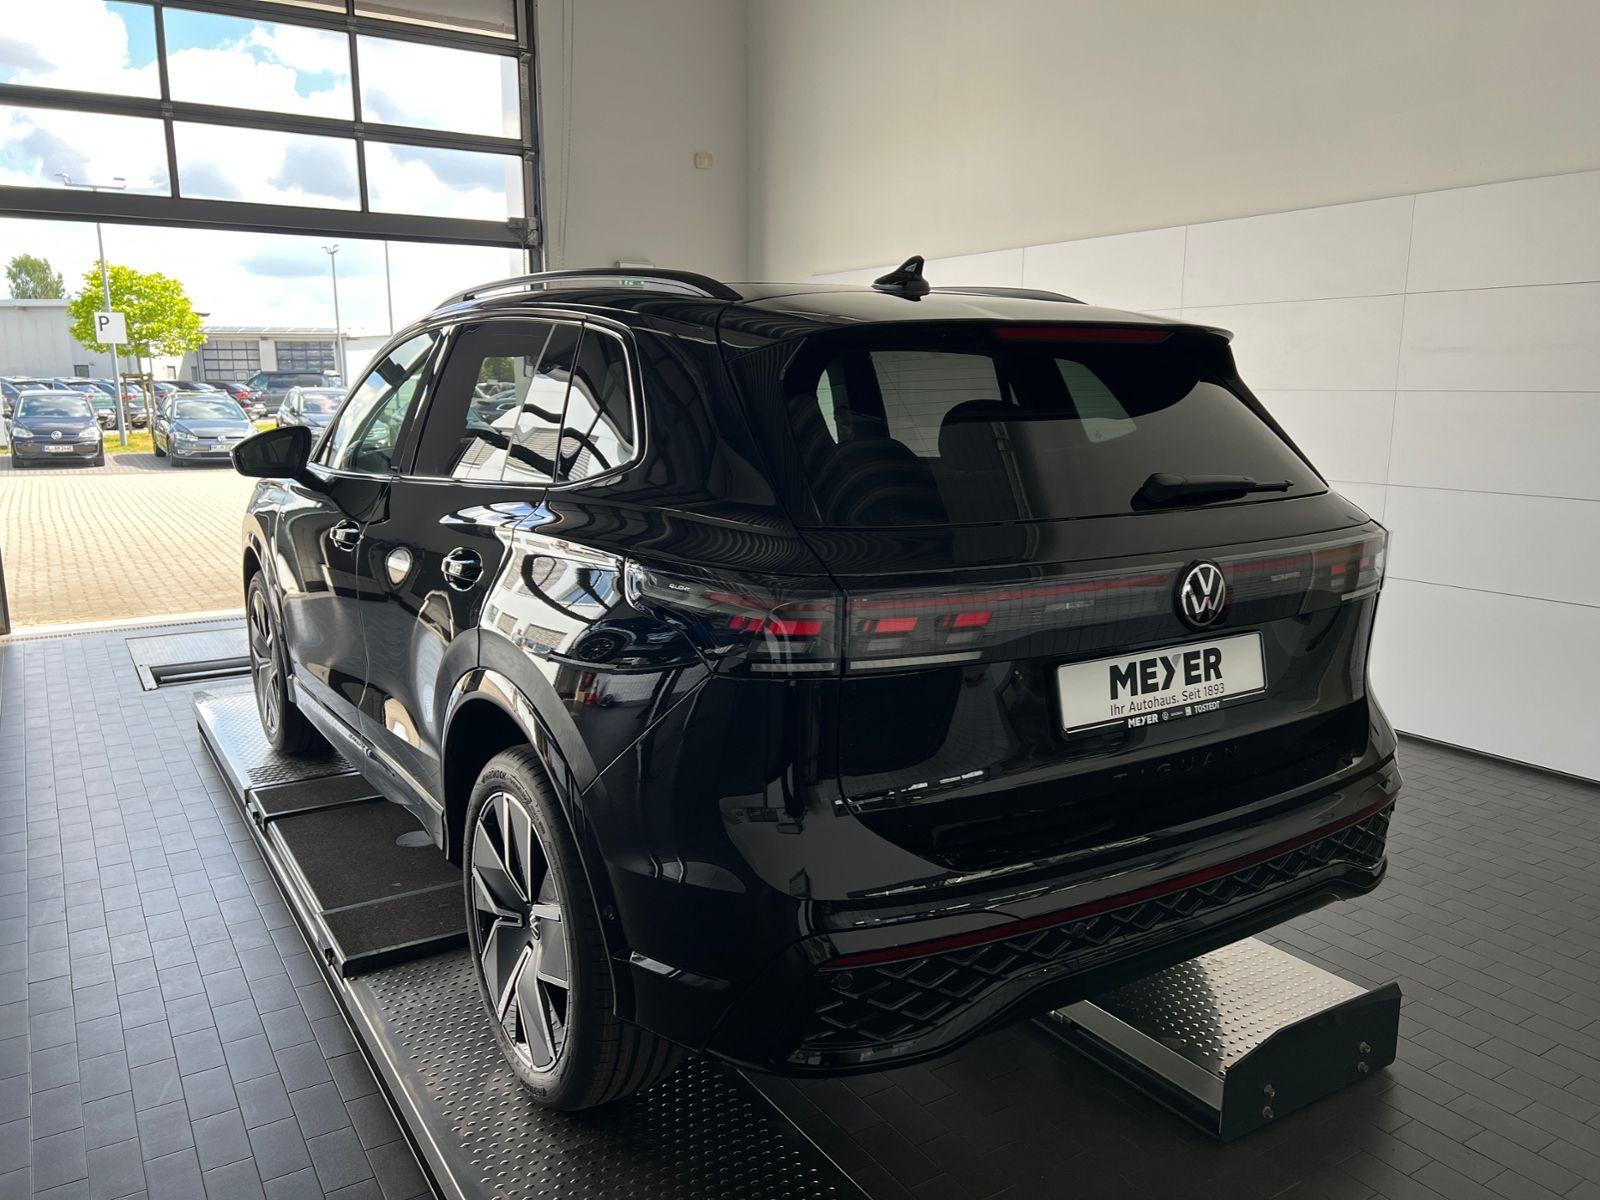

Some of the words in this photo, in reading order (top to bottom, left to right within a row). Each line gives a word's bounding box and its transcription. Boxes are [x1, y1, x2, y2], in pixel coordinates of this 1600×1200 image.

[98, 315, 110, 331] P
[1109, 647, 1223, 701] MEYER
[1110, 703, 1125, 717] Ihr
[1128, 694, 1180, 713] Autohaus.
[1182, 686, 1201, 702] Seit
[1204, 682, 1225, 698] 1893
[1128, 713, 1158, 728] MEYER
[1194, 700, 1221, 714] TOSTEDT
